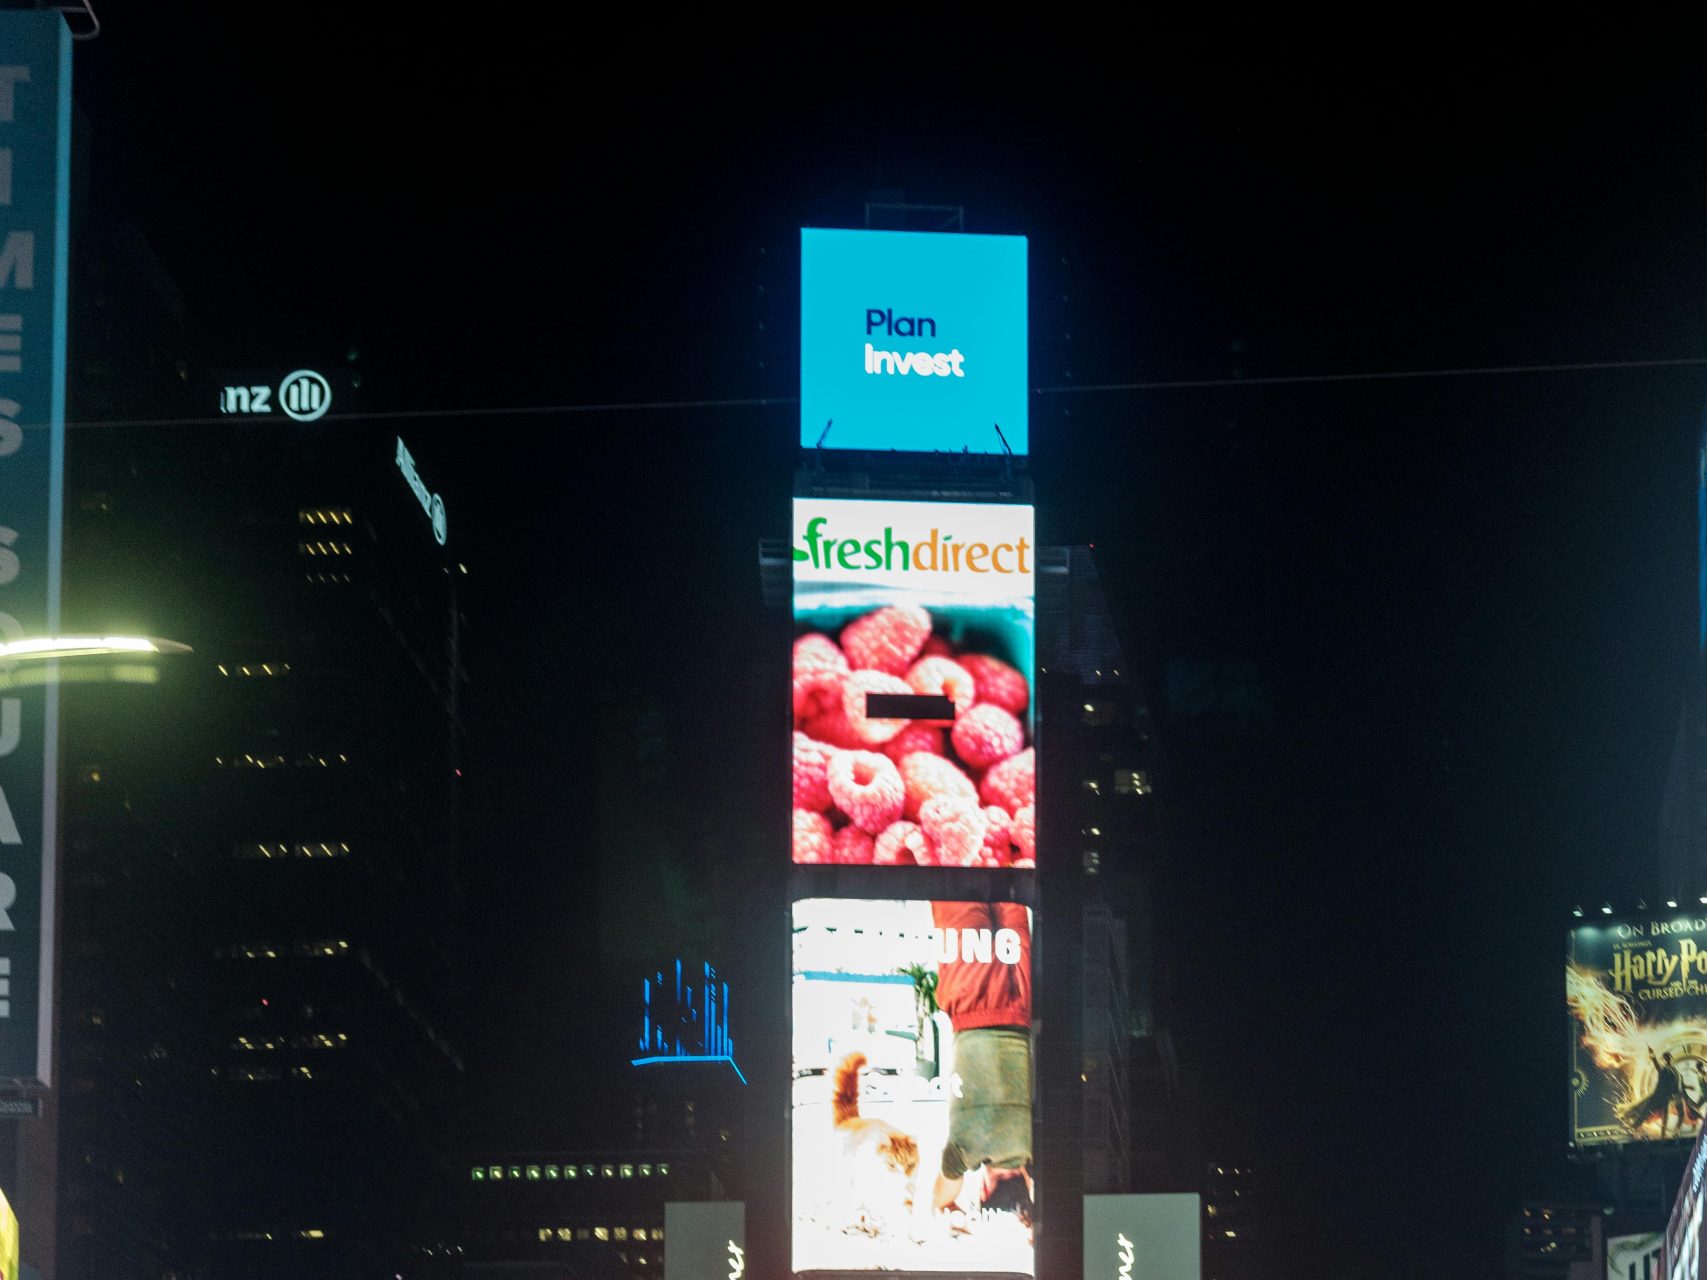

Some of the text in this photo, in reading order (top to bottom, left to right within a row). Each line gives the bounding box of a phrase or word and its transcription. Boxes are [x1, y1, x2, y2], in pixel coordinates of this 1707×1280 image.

[865, 307, 937, 338] Plan
[864, 343, 965, 378] Invest
[801, 516, 1030, 574] freshdirect
[1617, 923, 1644, 939] ON
[1608, 947, 1679, 994] Harry
[1638, 984, 1684, 1000] CURSED
